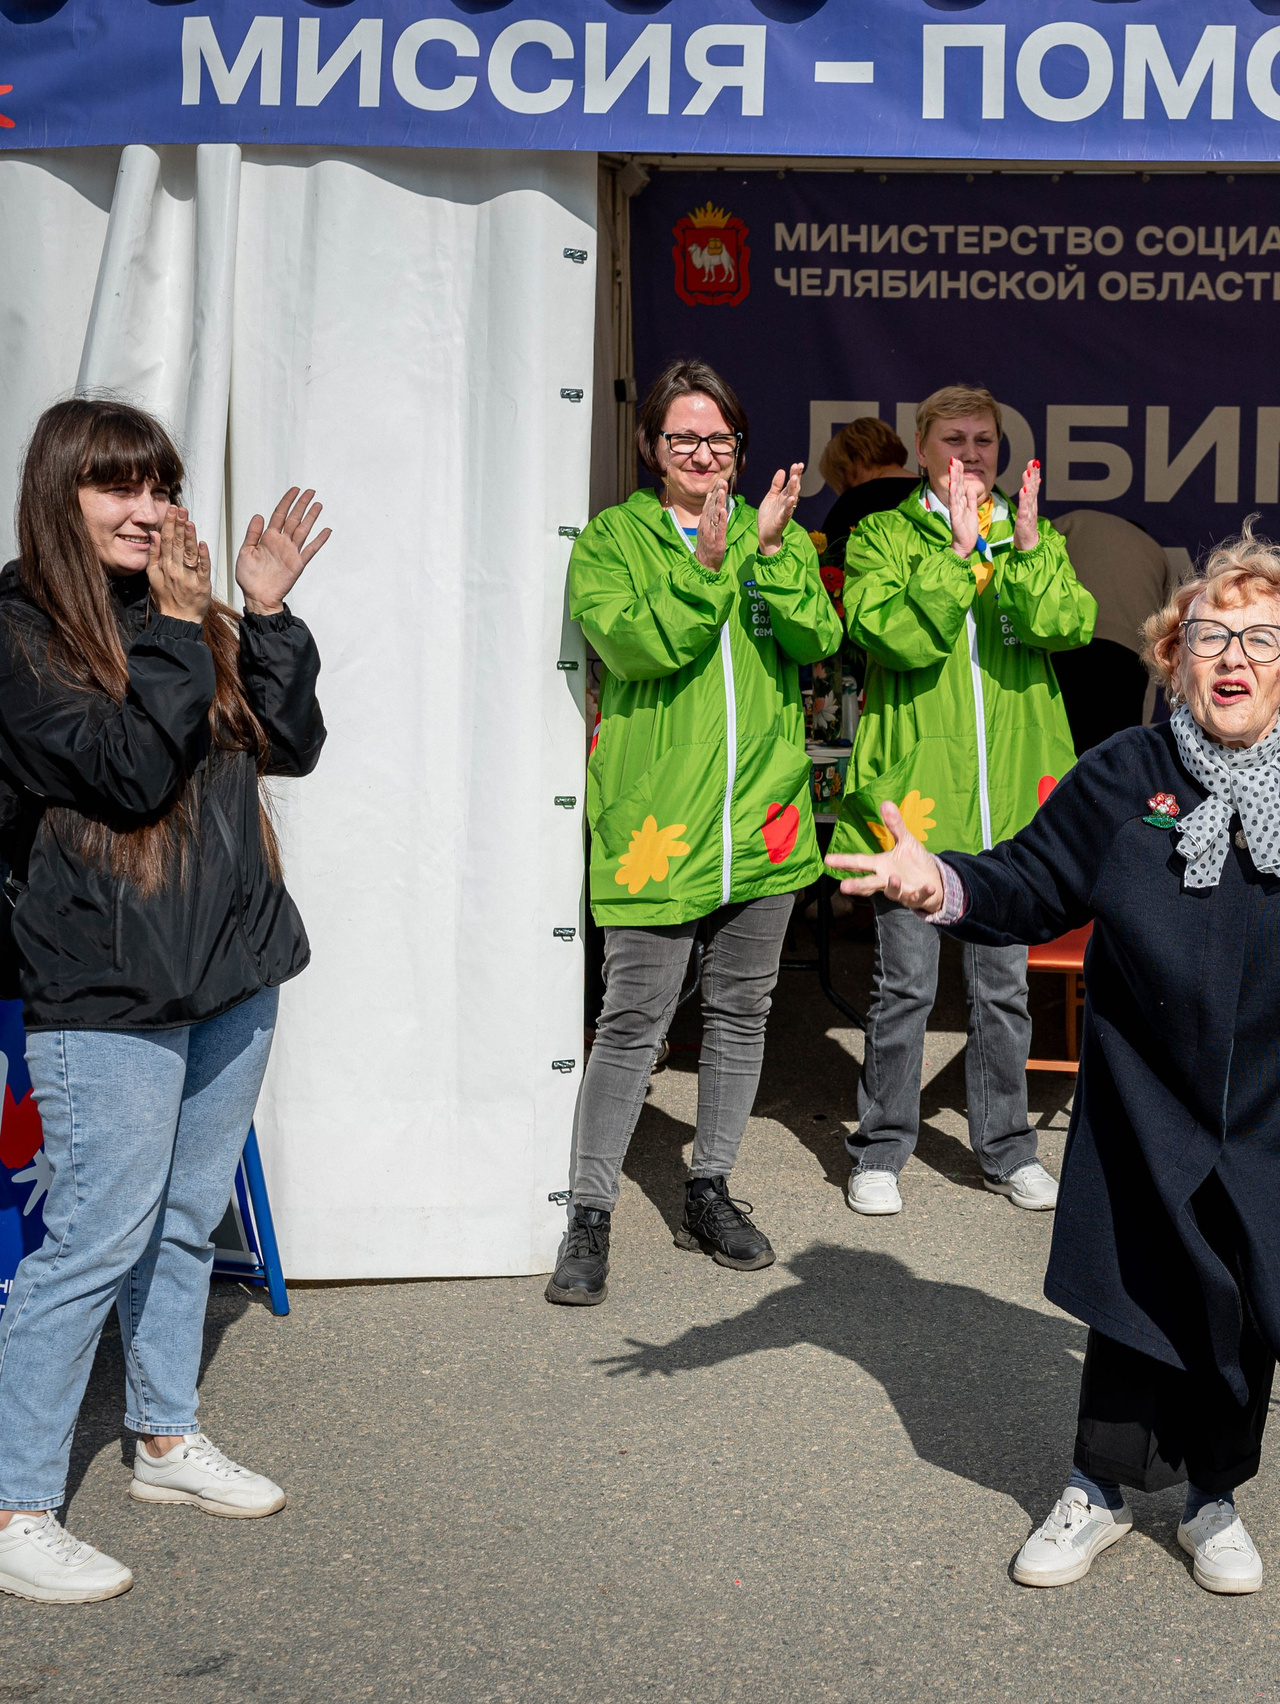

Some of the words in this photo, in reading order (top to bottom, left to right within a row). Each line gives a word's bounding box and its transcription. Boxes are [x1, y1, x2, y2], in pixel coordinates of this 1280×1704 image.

[182, 15, 767, 117] МИССИЯ
[774, 222, 1124, 256] МИНИСТЕРСТВО
[774, 263, 1085, 302] ЧЕЛЯБИНСКОЙ
